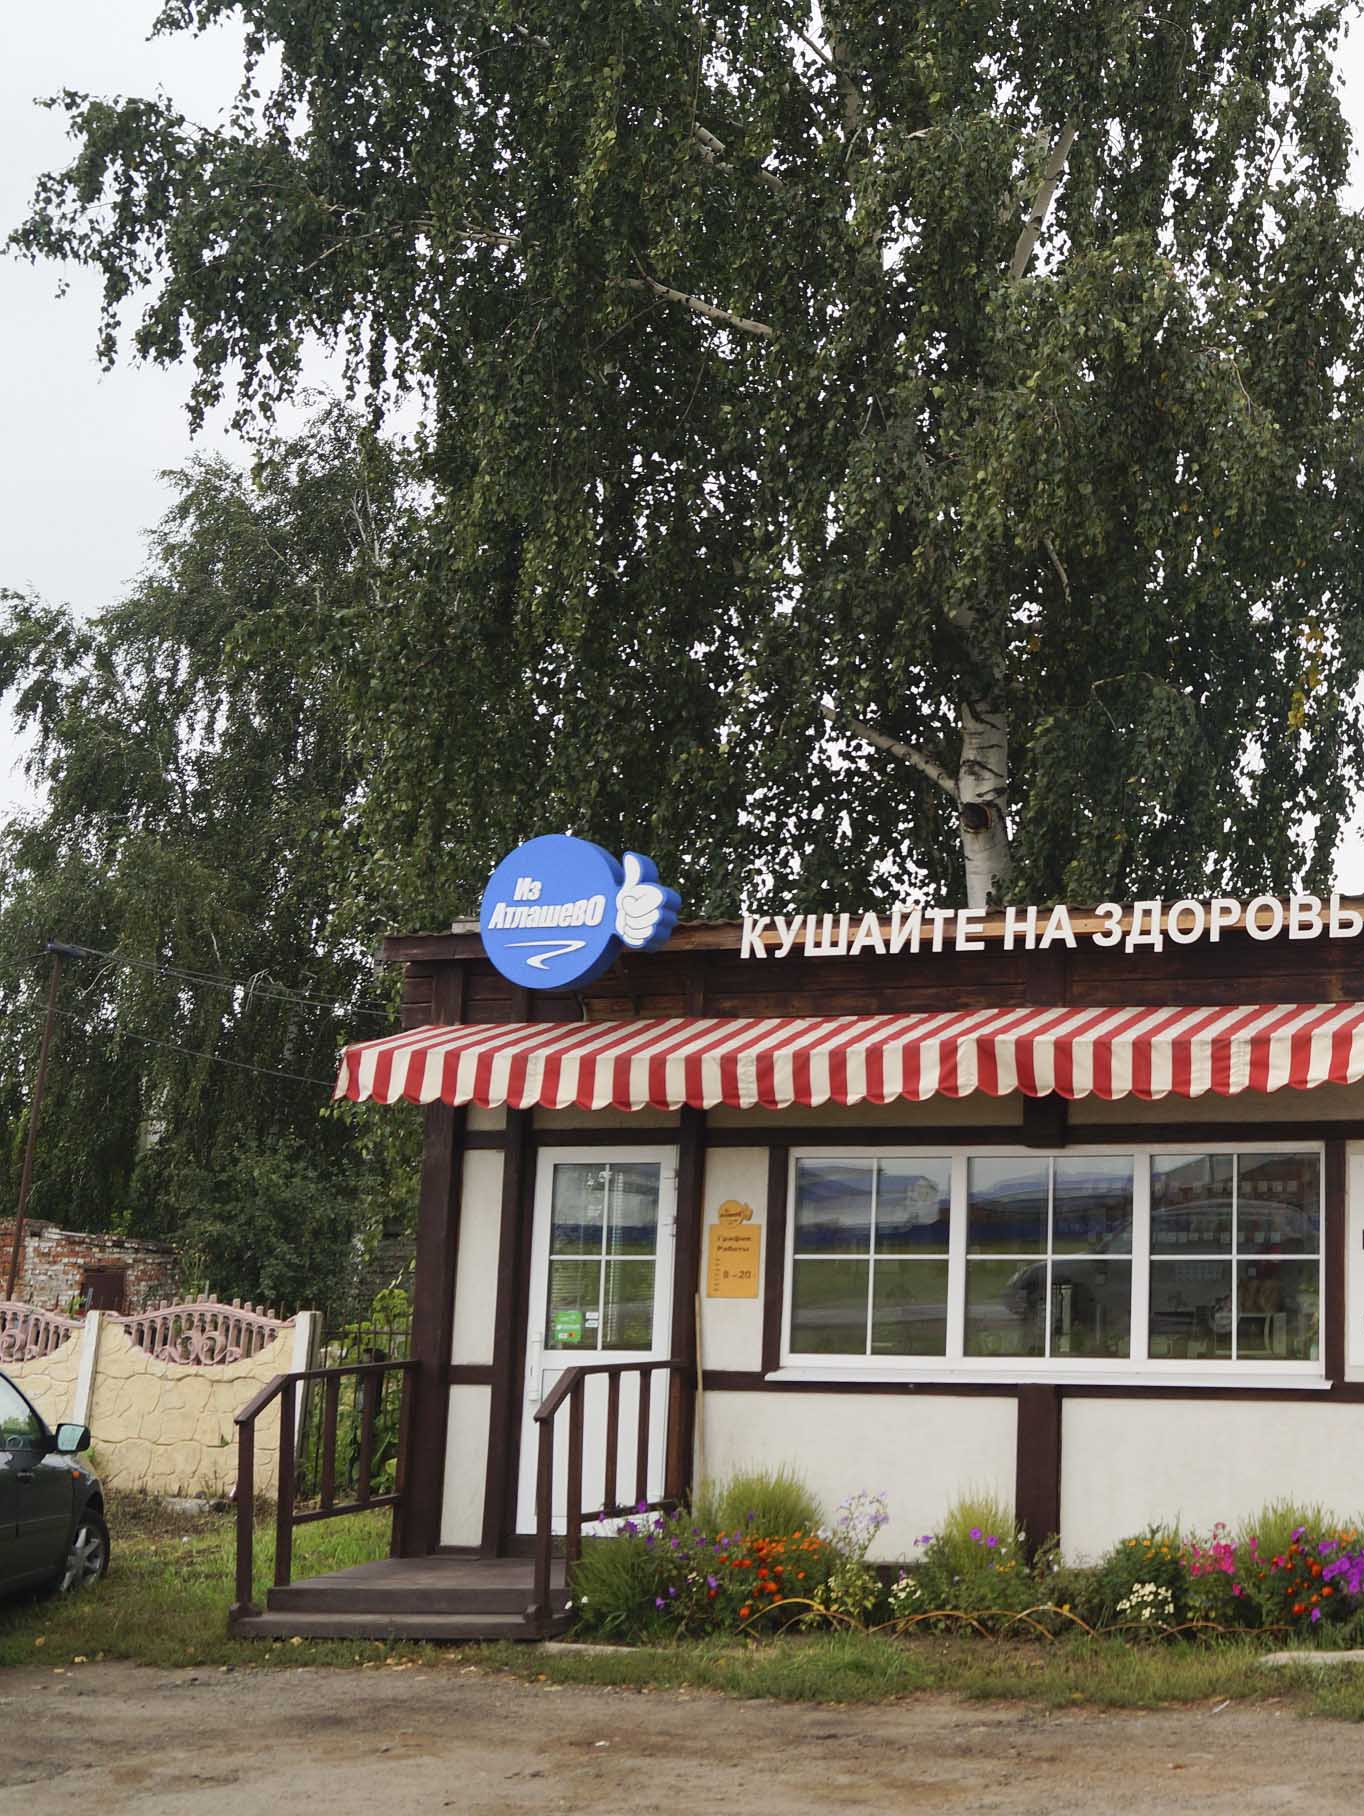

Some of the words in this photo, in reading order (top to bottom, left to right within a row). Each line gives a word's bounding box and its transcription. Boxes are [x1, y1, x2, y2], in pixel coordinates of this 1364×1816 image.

[513, 877, 542, 901] Из
[740, 904, 986, 959] КУШАЙТЕ
[1003, 904, 1078, 951] НА
